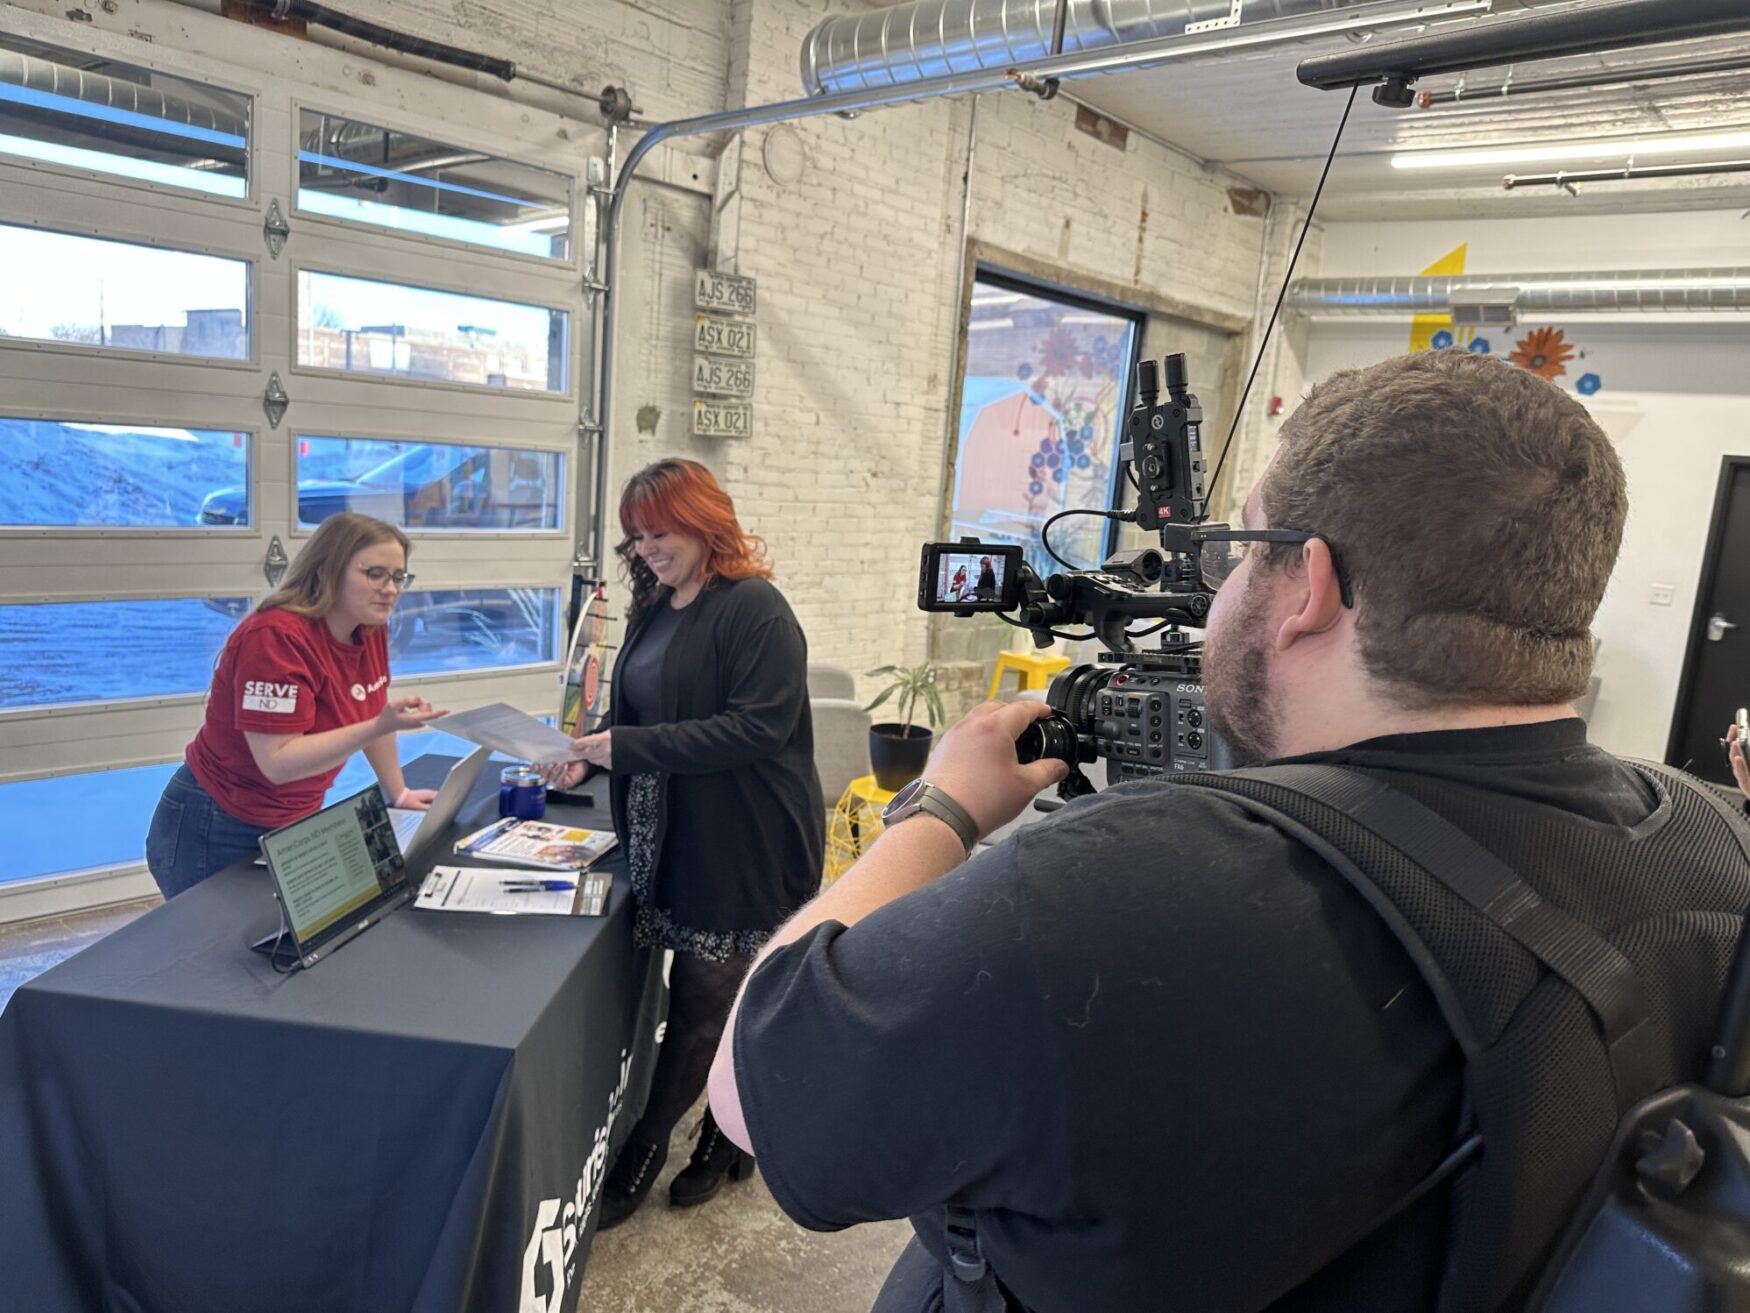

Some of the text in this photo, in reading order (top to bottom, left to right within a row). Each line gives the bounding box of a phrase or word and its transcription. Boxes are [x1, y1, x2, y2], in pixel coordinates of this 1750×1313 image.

[698, 278, 724, 301] AJS
[727, 283, 753, 305] 266
[698, 324, 751, 349] ASX 021
[696, 365, 721, 385] AJS
[725, 369, 751, 389] 266
[696, 409, 748, 430] ASX 021
[1158, 506, 1169, 515] 4K
[244, 680, 299, 698] SERVE
[1176, 683, 1205, 693] SON
[259, 699, 278, 710] ND
